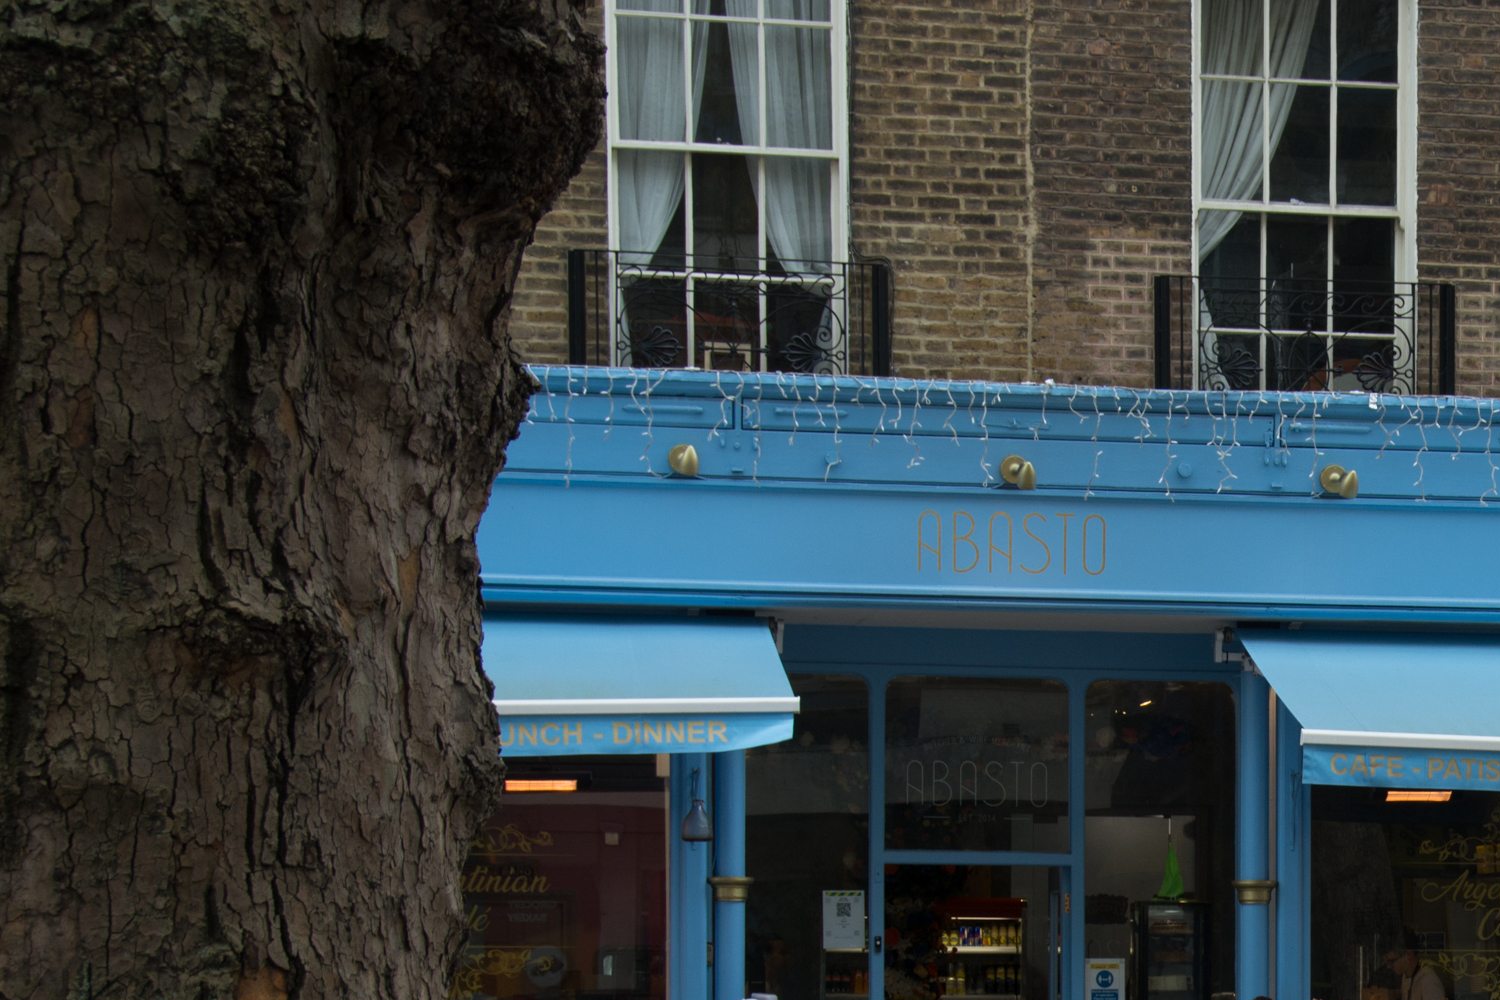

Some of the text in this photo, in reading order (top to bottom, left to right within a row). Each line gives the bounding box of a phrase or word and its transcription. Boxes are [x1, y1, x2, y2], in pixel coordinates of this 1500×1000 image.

[917, 510, 1107, 576] ABASTO
[612, 721, 729, 744] DINNER
[906, 759, 1048, 808] ABASTO
[1330, 753, 1404, 778] CAFE
